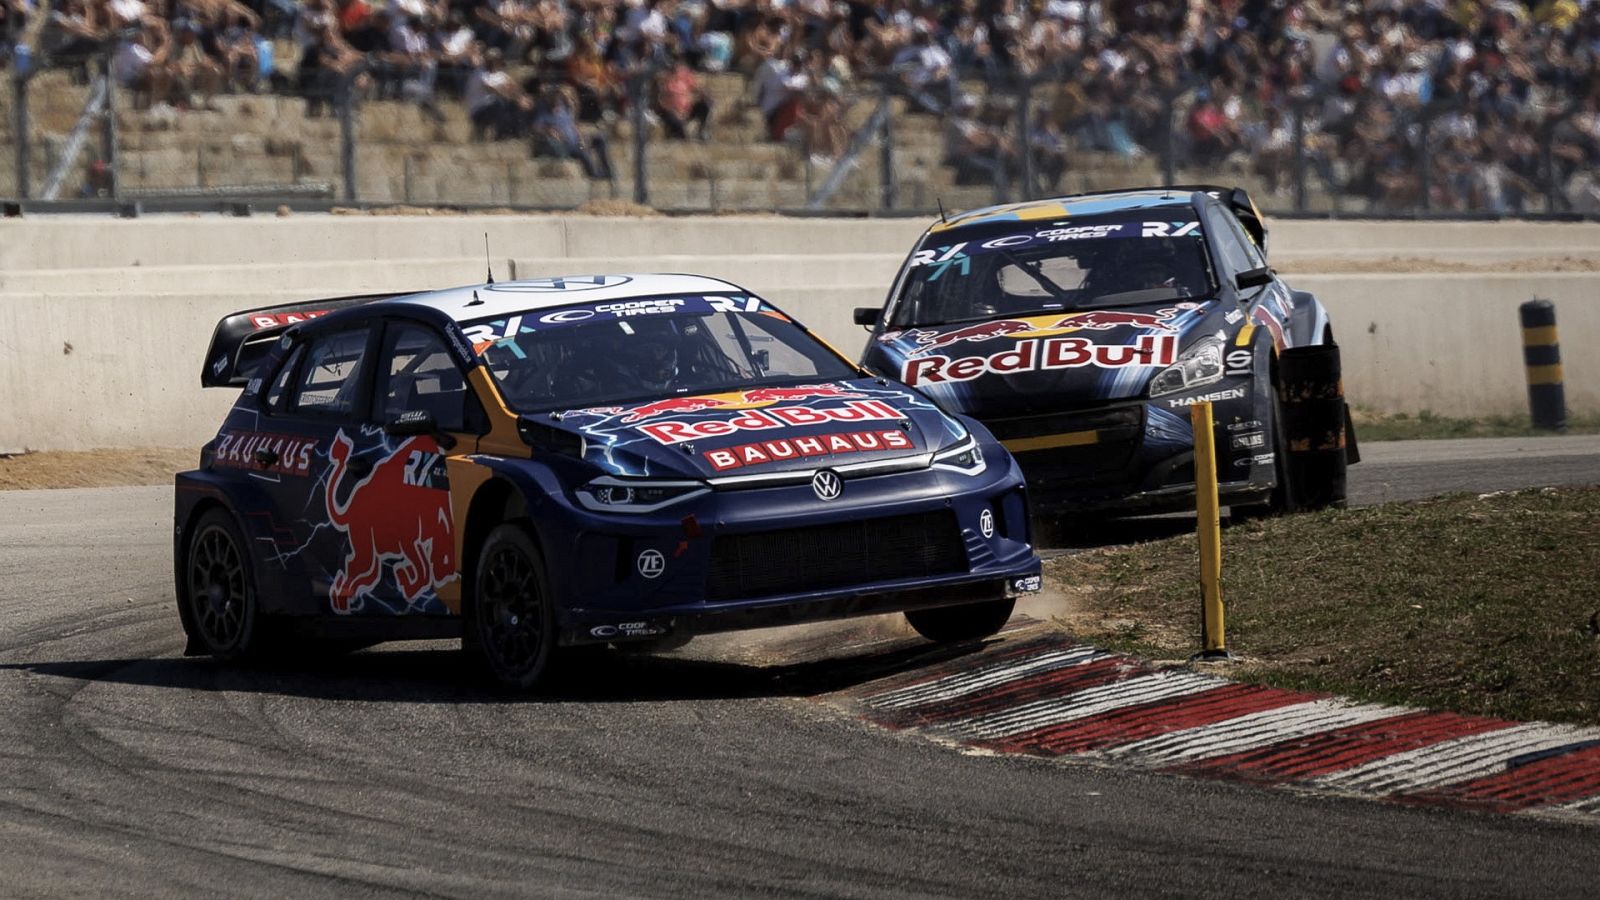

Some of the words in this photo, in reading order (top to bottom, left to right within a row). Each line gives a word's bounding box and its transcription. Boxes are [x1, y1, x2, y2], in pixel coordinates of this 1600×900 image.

[1035, 224, 1123, 237] COOPER
[1047, 231, 1108, 242] TIRES
[1141, 221, 1202, 238] RX
[909, 241, 968, 267] RX
[927, 256, 971, 281] 71
[595, 298, 686, 313] COOPER
[611, 304, 677, 317] TIRES
[905, 340, 1033, 386] Red
[1046, 336, 1175, 367] Bull
[1168, 388, 1245, 408] HANSEN
[642, 409, 780, 444] Red
[770, 401, 902, 426] Bull
[709, 430, 907, 469] BAUHAUS
[639, 552, 663, 575] ZF
